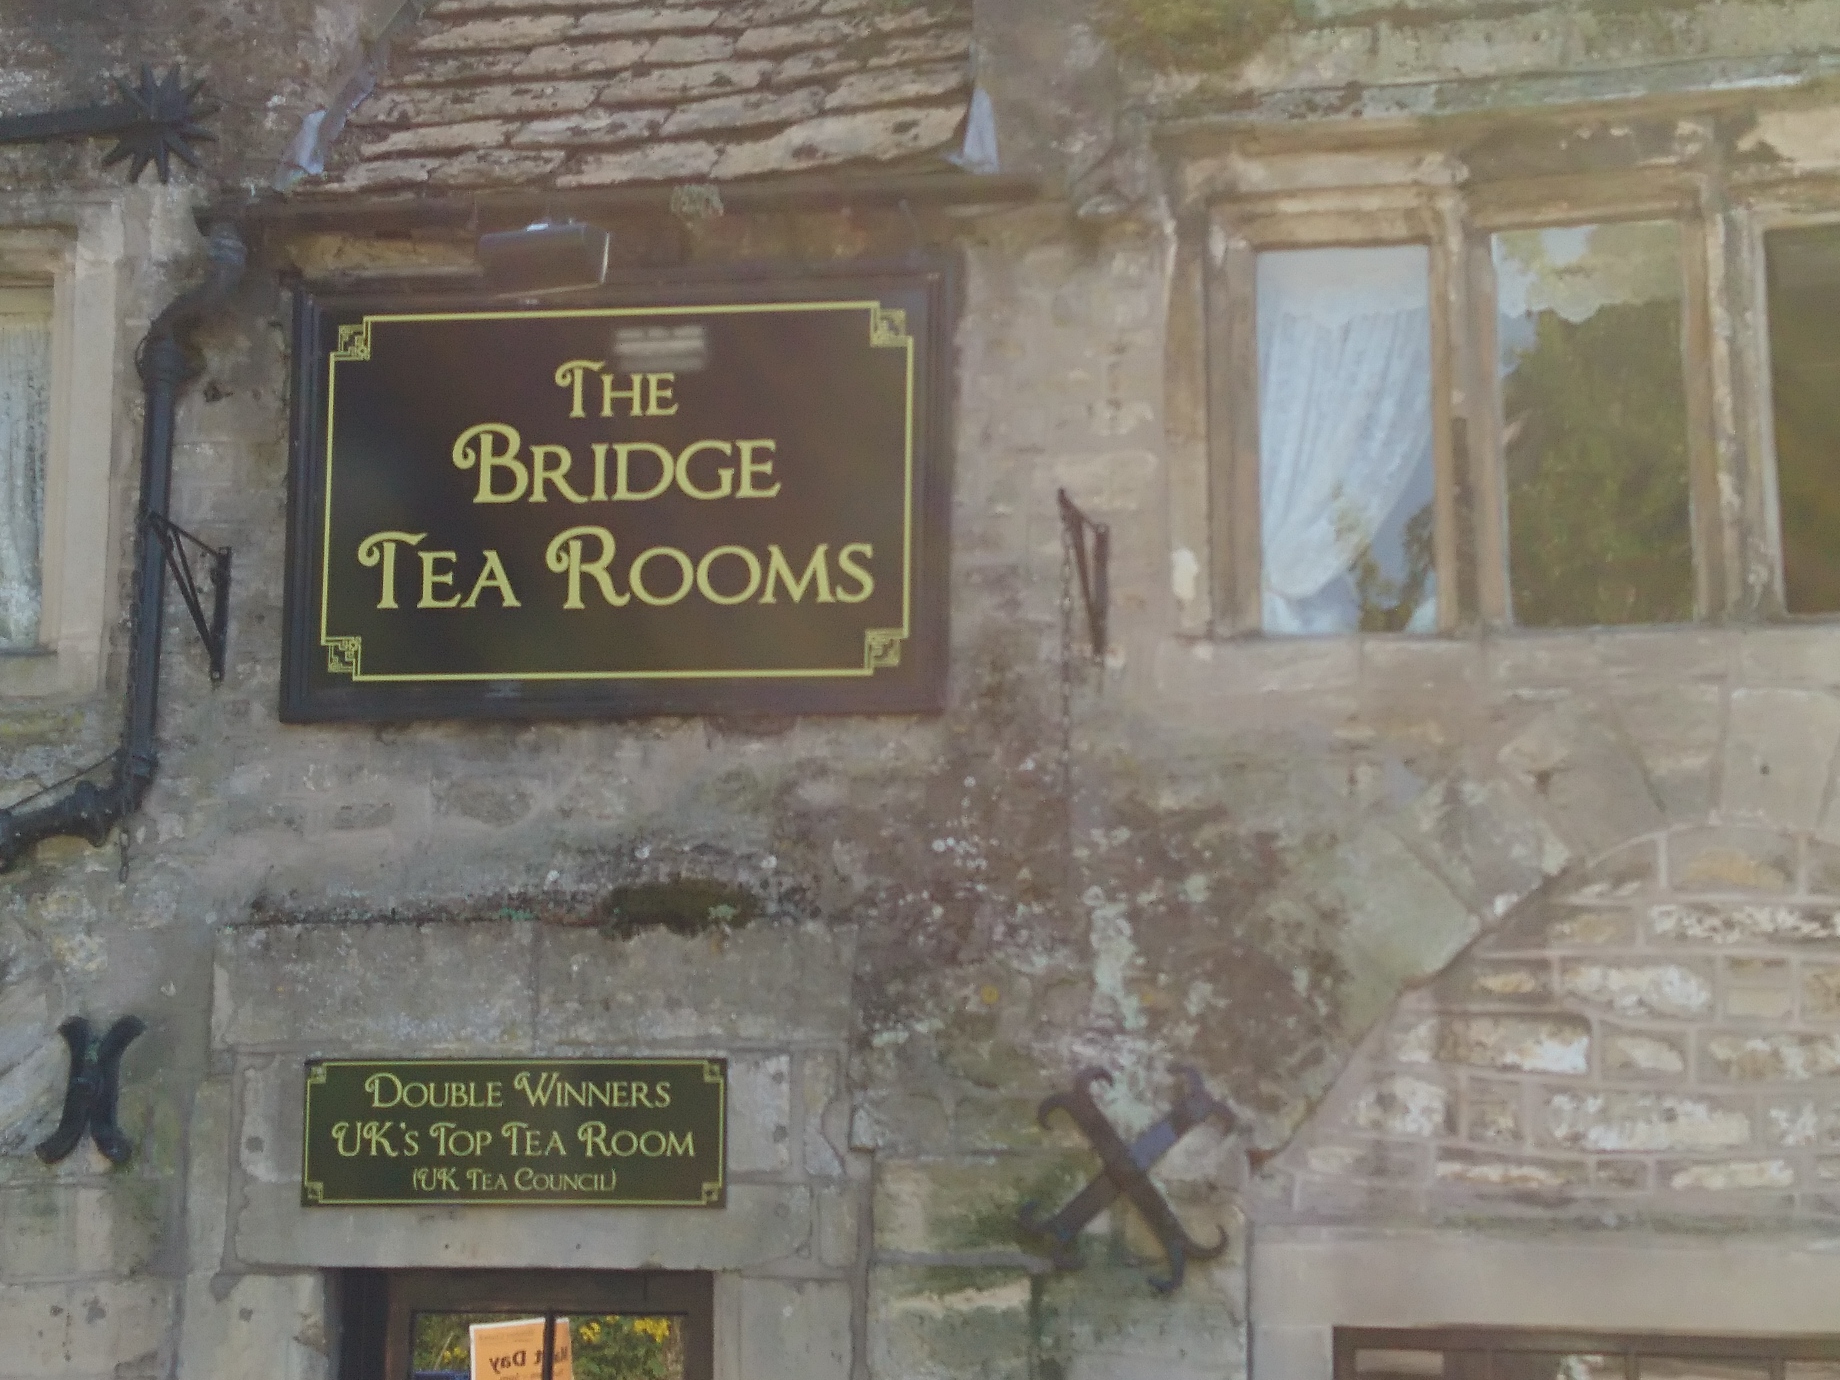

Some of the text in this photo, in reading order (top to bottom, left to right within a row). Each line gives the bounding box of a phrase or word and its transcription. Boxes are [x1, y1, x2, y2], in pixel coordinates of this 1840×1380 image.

[555, 359, 679, 419] THE
[453, 422, 782, 504] BRIDGE
[358, 525, 876, 610] TEA ROOMS
[364, 1071, 672, 1108] DOUBLE WINNERS
[429, 1122, 492, 1157] TOP
[501, 1121, 567, 1157] TEA
[577, 1120, 696, 1157] ROOM
